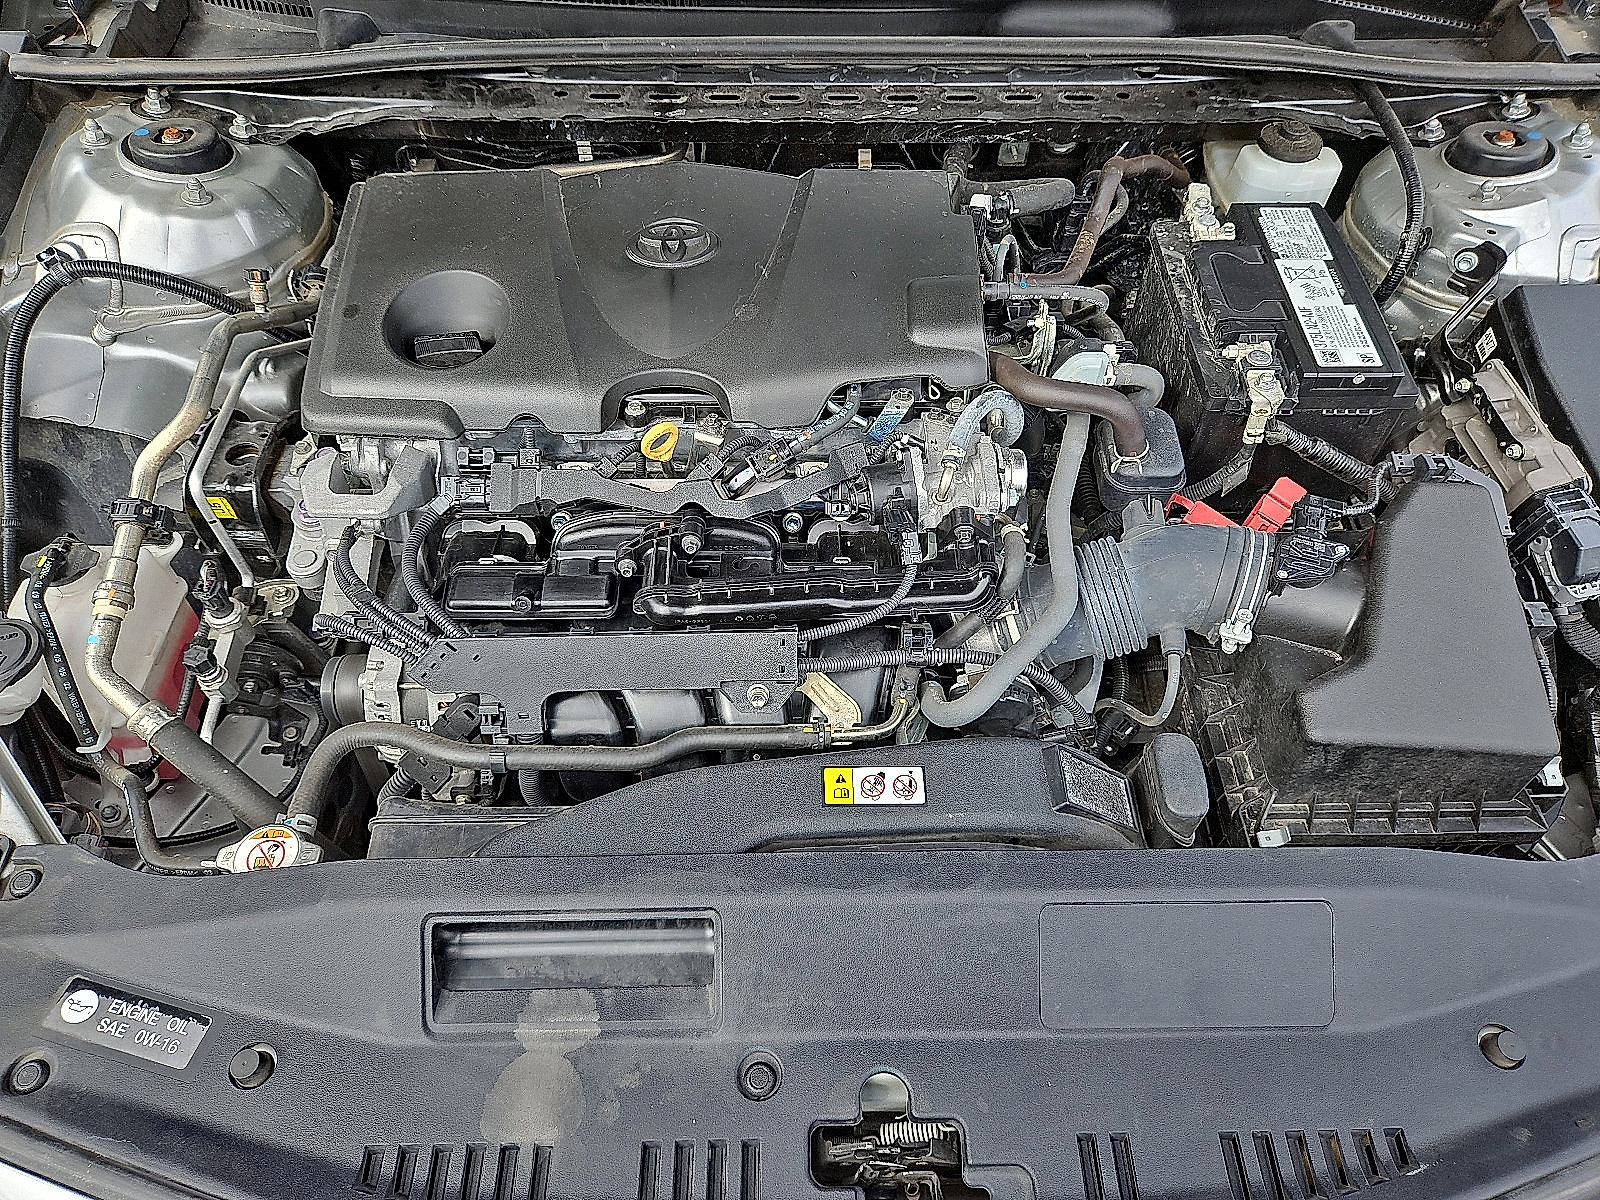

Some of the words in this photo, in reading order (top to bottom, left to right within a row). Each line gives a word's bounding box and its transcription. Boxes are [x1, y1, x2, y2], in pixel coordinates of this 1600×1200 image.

[96, 1017, 130, 1039] SAE
[134, 1029, 181, 1054] 0W-16
[107, 999, 162, 1026] ENGINE
[166, 1017, 189, 1036] OIL
